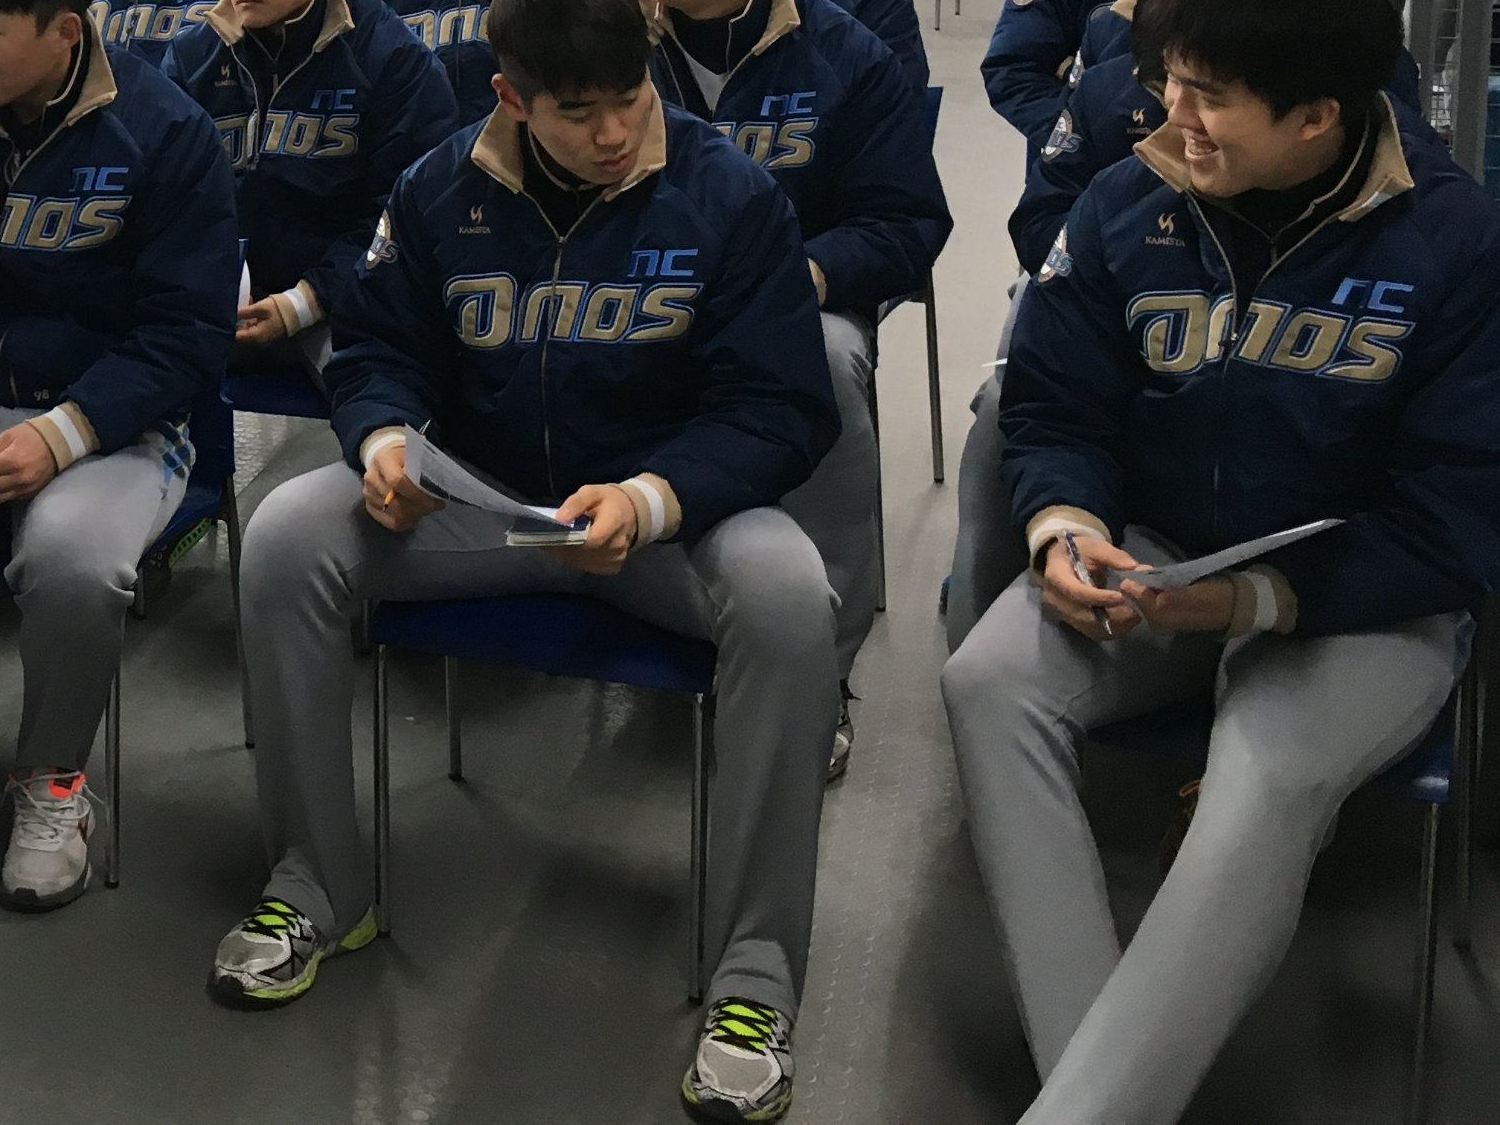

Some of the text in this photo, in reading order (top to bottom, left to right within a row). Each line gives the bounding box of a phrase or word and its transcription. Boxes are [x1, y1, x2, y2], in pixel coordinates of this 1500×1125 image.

[458, 226, 491, 234] KAMISTA
[1145, 235, 1186, 248] KAMISTA
[627, 248, 699, 277] NC
[33, 388, 50, 401] 98
